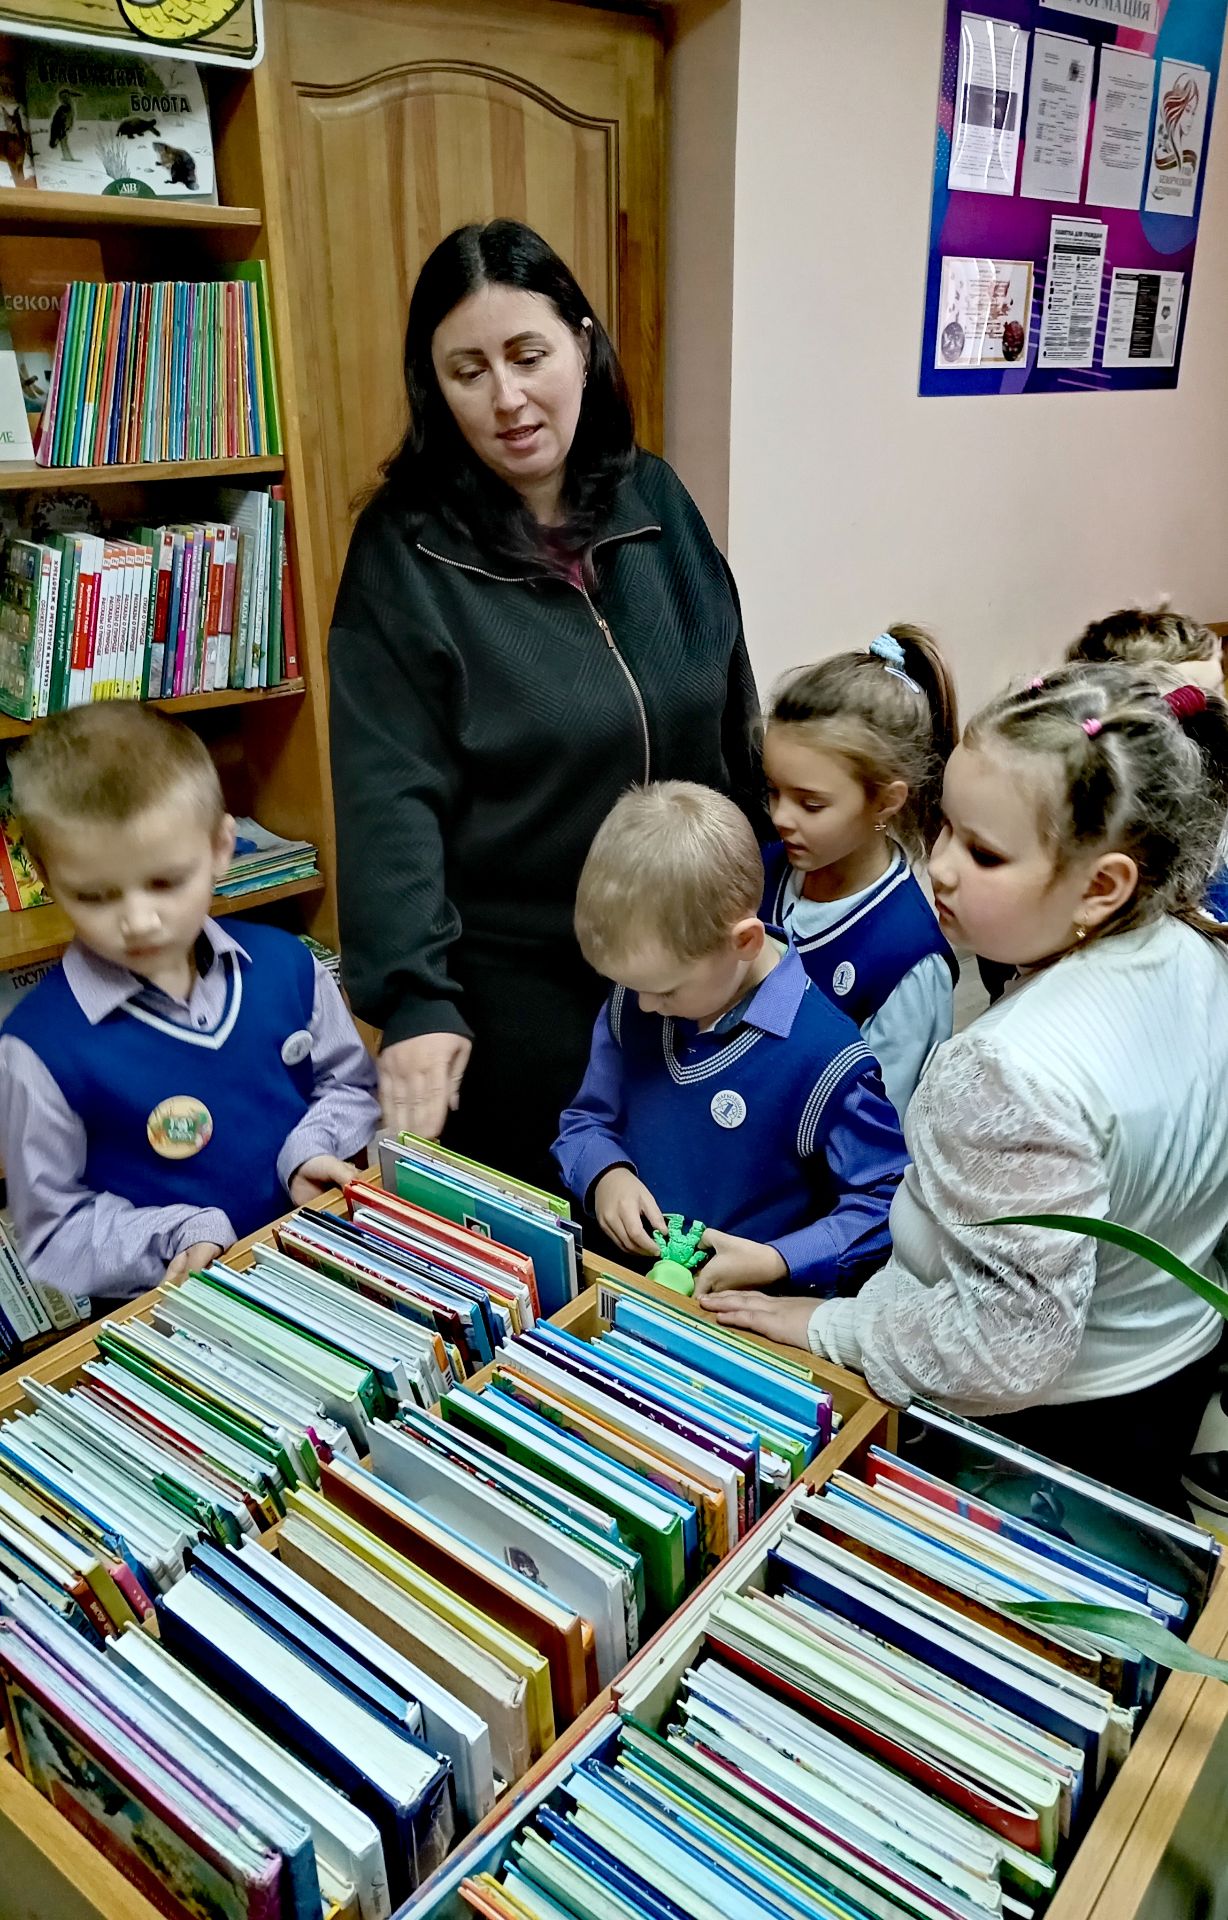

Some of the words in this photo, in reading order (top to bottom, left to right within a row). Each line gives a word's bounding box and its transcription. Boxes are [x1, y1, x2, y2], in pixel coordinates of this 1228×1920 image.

[131, 94, 191, 113] БОЛОТА
[838, 971, 846, 985] 1
[720, 1101, 734, 1119] 1
